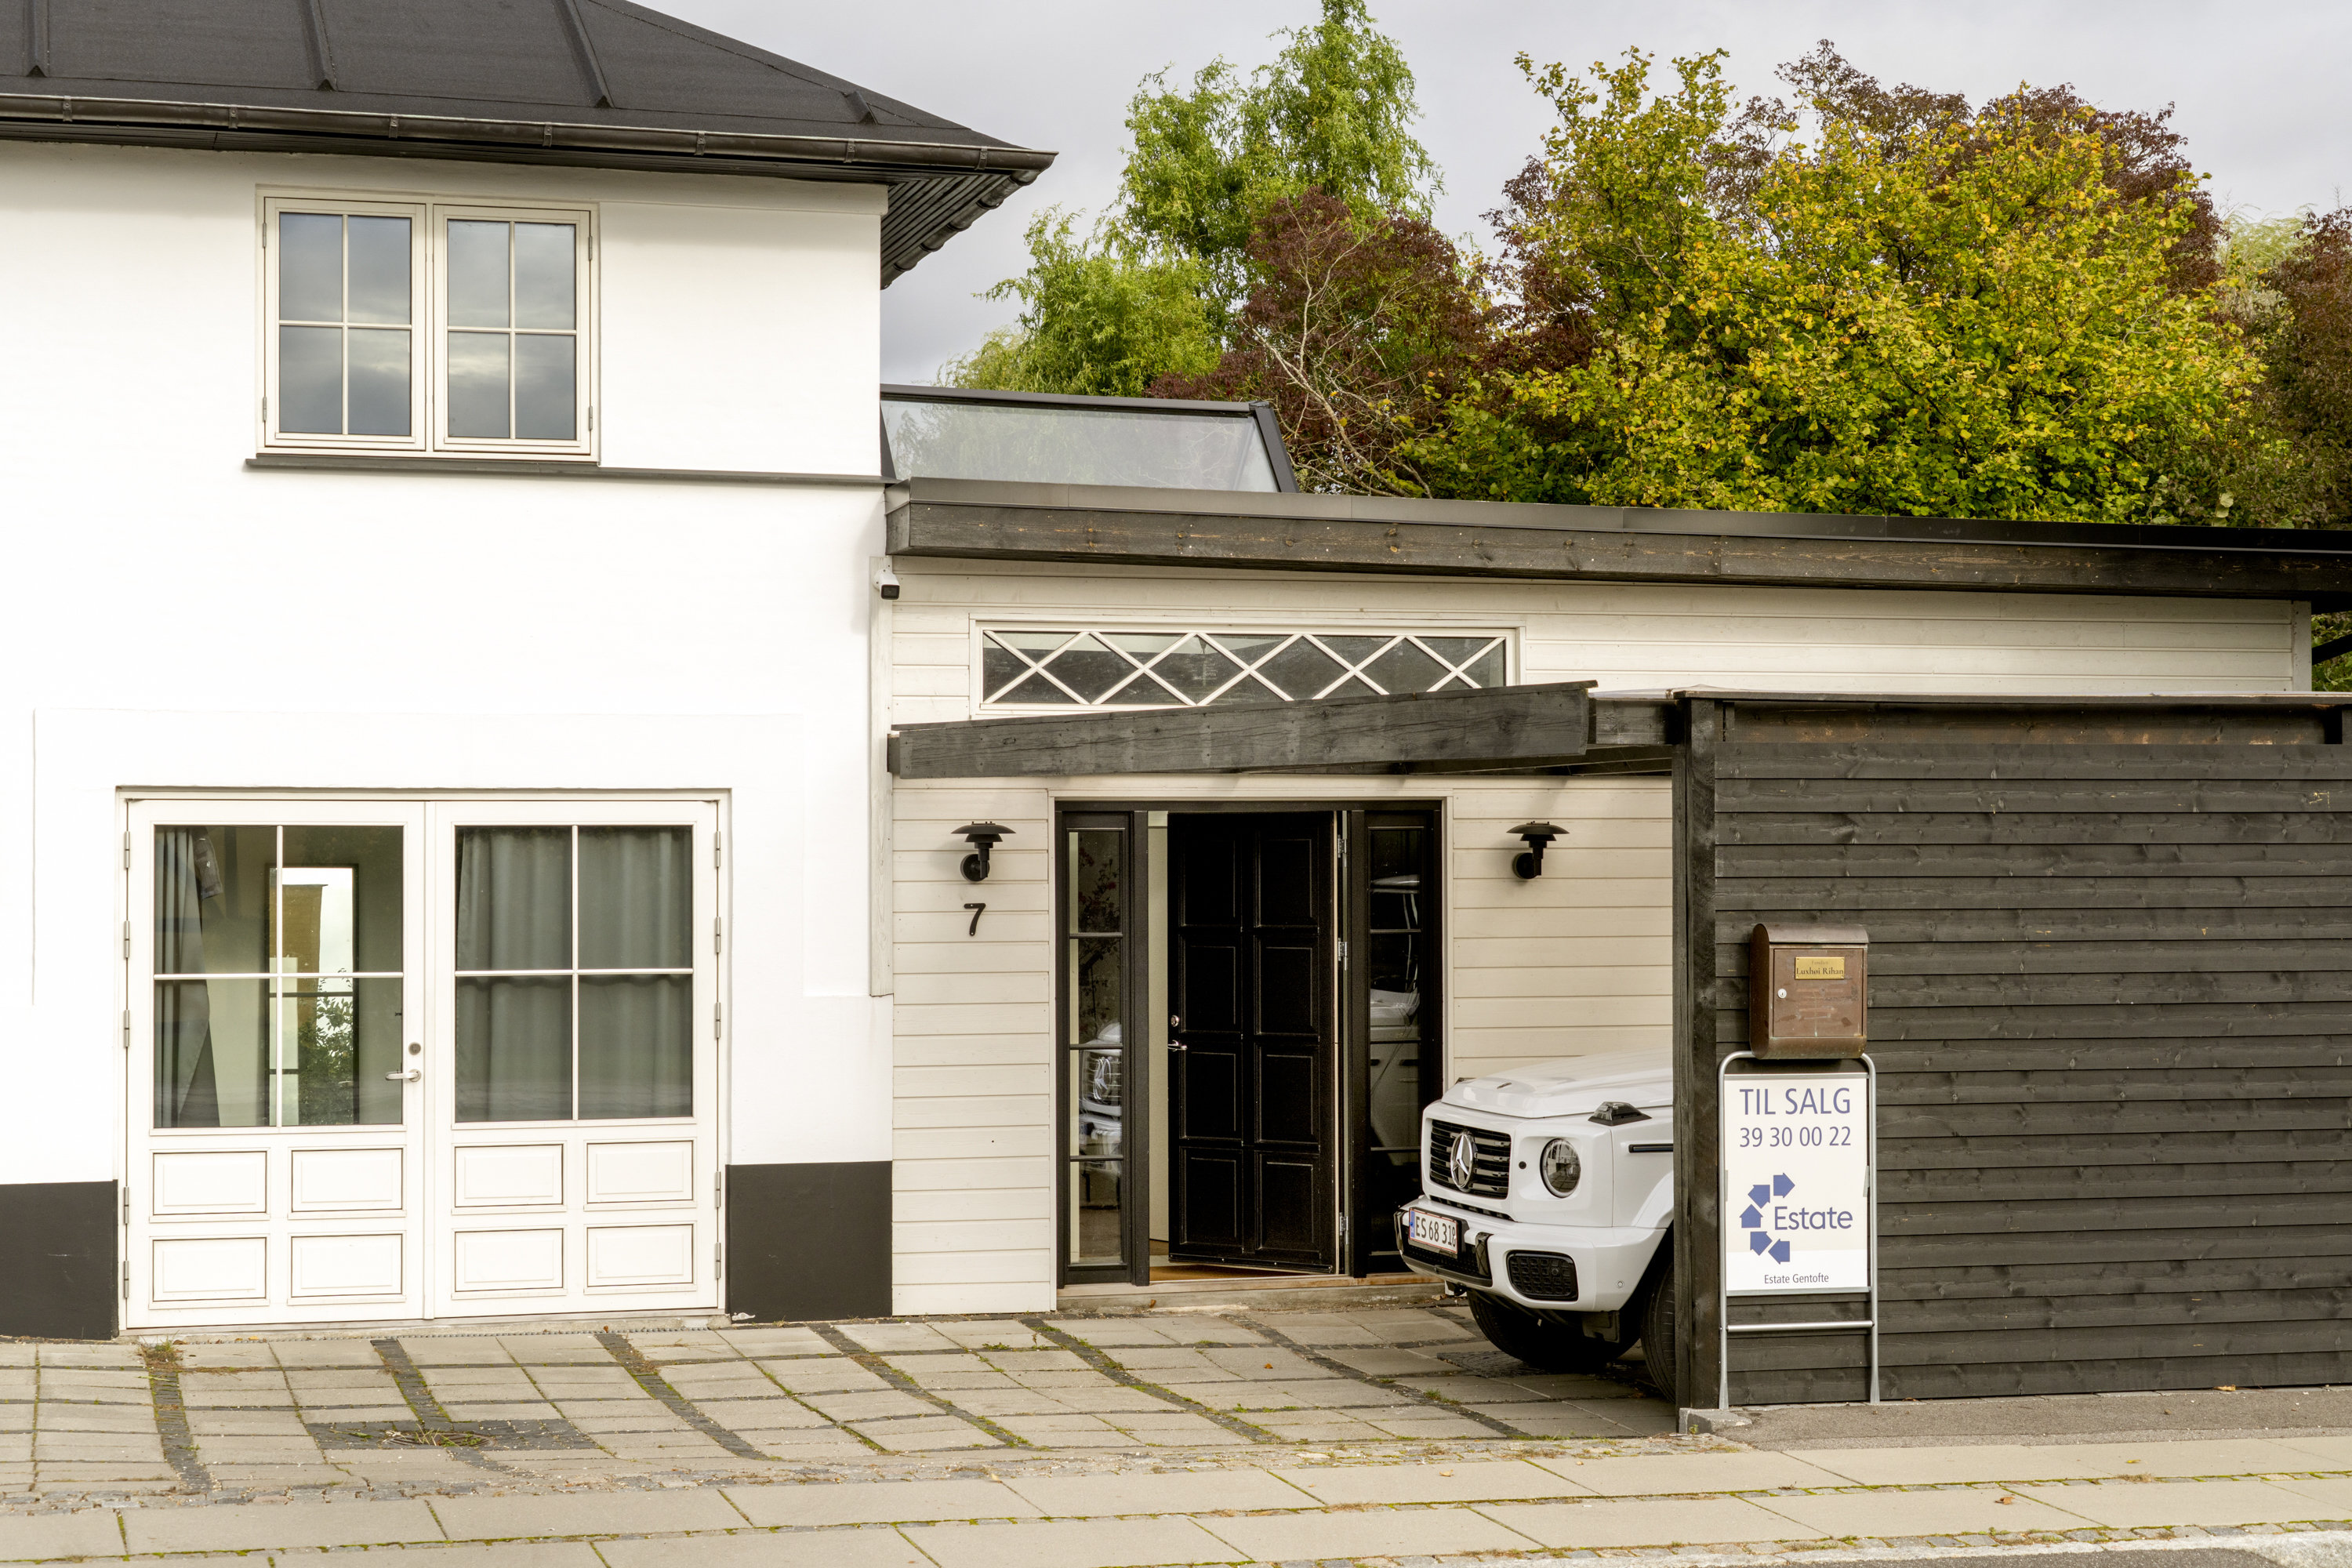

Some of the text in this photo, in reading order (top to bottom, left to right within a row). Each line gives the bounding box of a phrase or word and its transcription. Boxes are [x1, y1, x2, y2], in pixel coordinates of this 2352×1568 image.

[964, 902, 986, 937] 7
[1739, 1087, 1850, 1115] TIL SALG
[1739, 1126, 1851, 1147] 39 30 00 22
[1774, 1206, 1853, 1230] Estate
[1416, 1216, 1456, 1247] ES 68 318
[1764, 1273, 1829, 1284] Estate Gentofte
